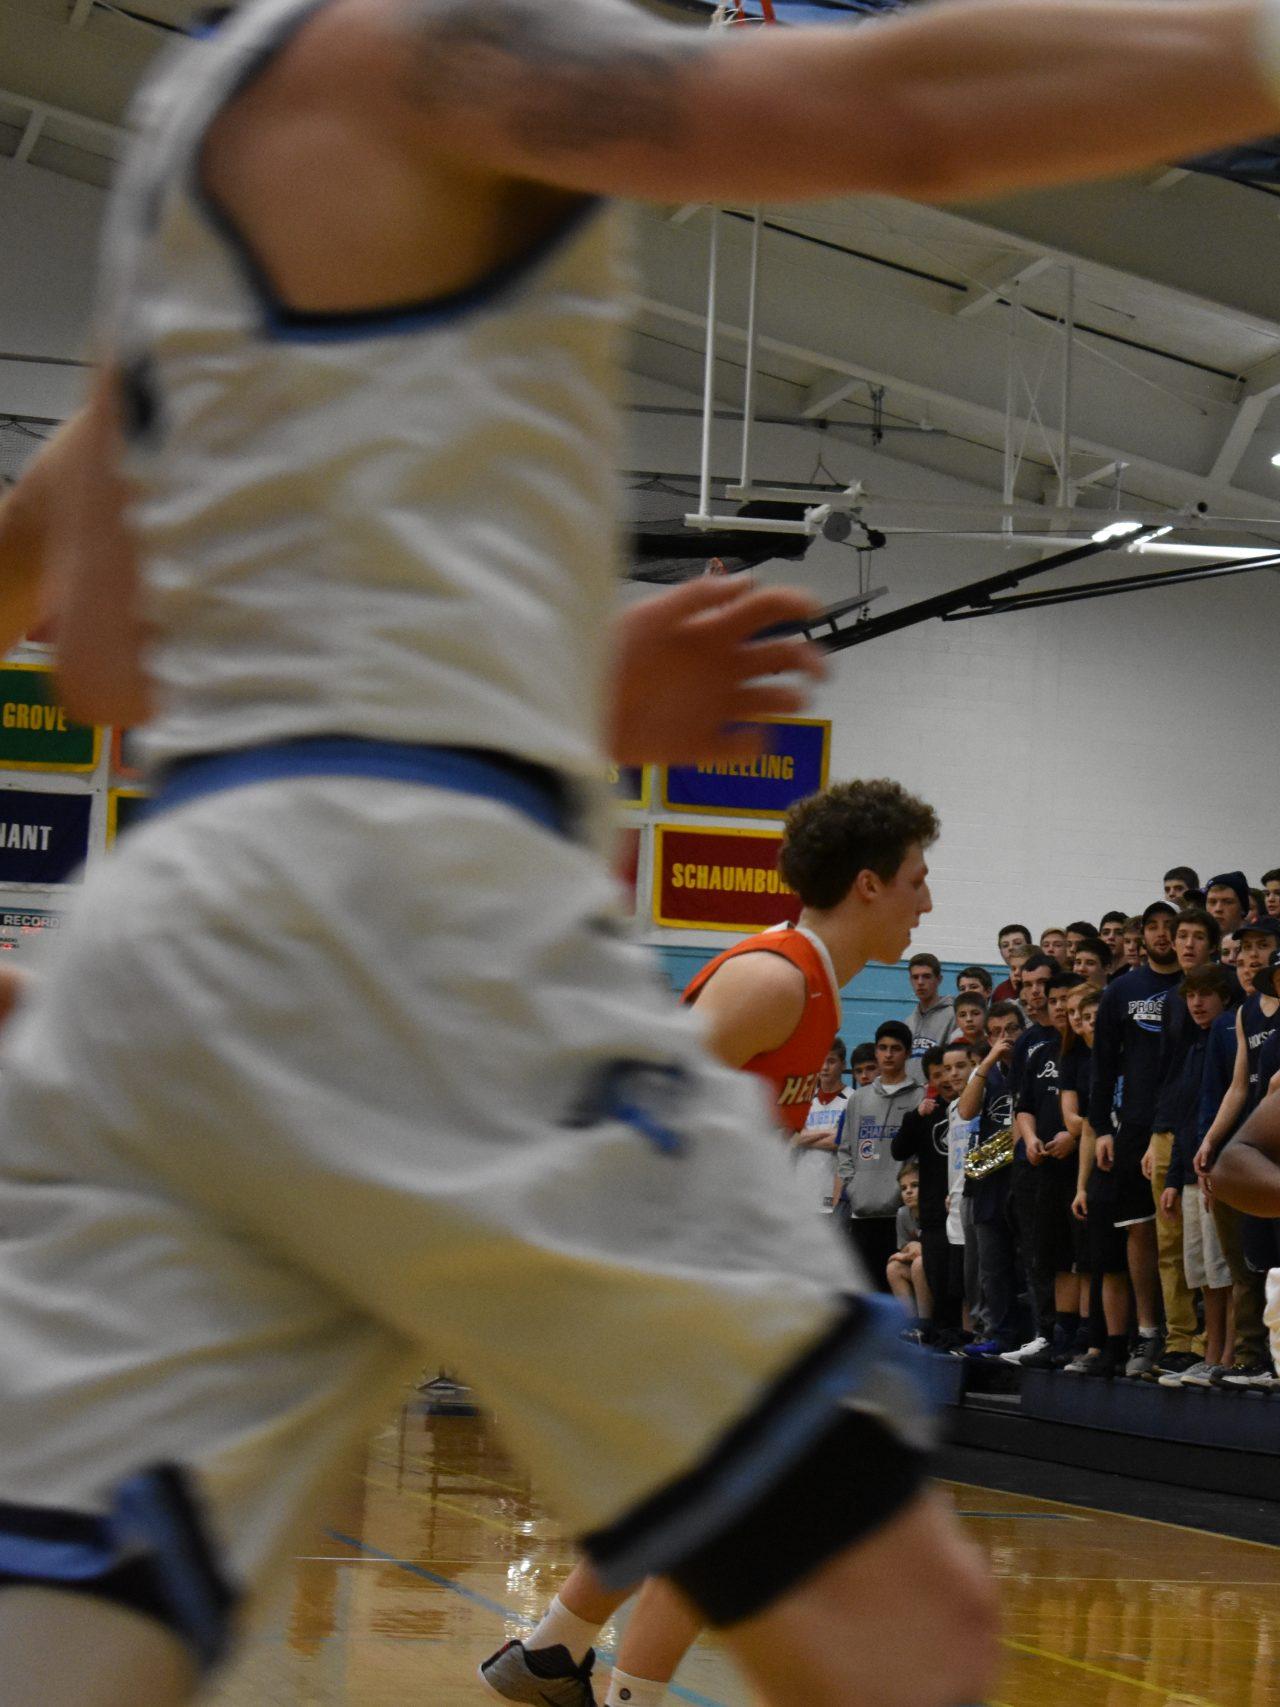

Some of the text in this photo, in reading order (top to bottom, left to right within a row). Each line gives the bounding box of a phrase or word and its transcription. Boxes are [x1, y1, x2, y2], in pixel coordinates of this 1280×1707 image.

[3, 702, 69, 732] GROVE
[671, 862, 799, 895] SCHAUMBU
[3, 913, 60, 928] RECORD
